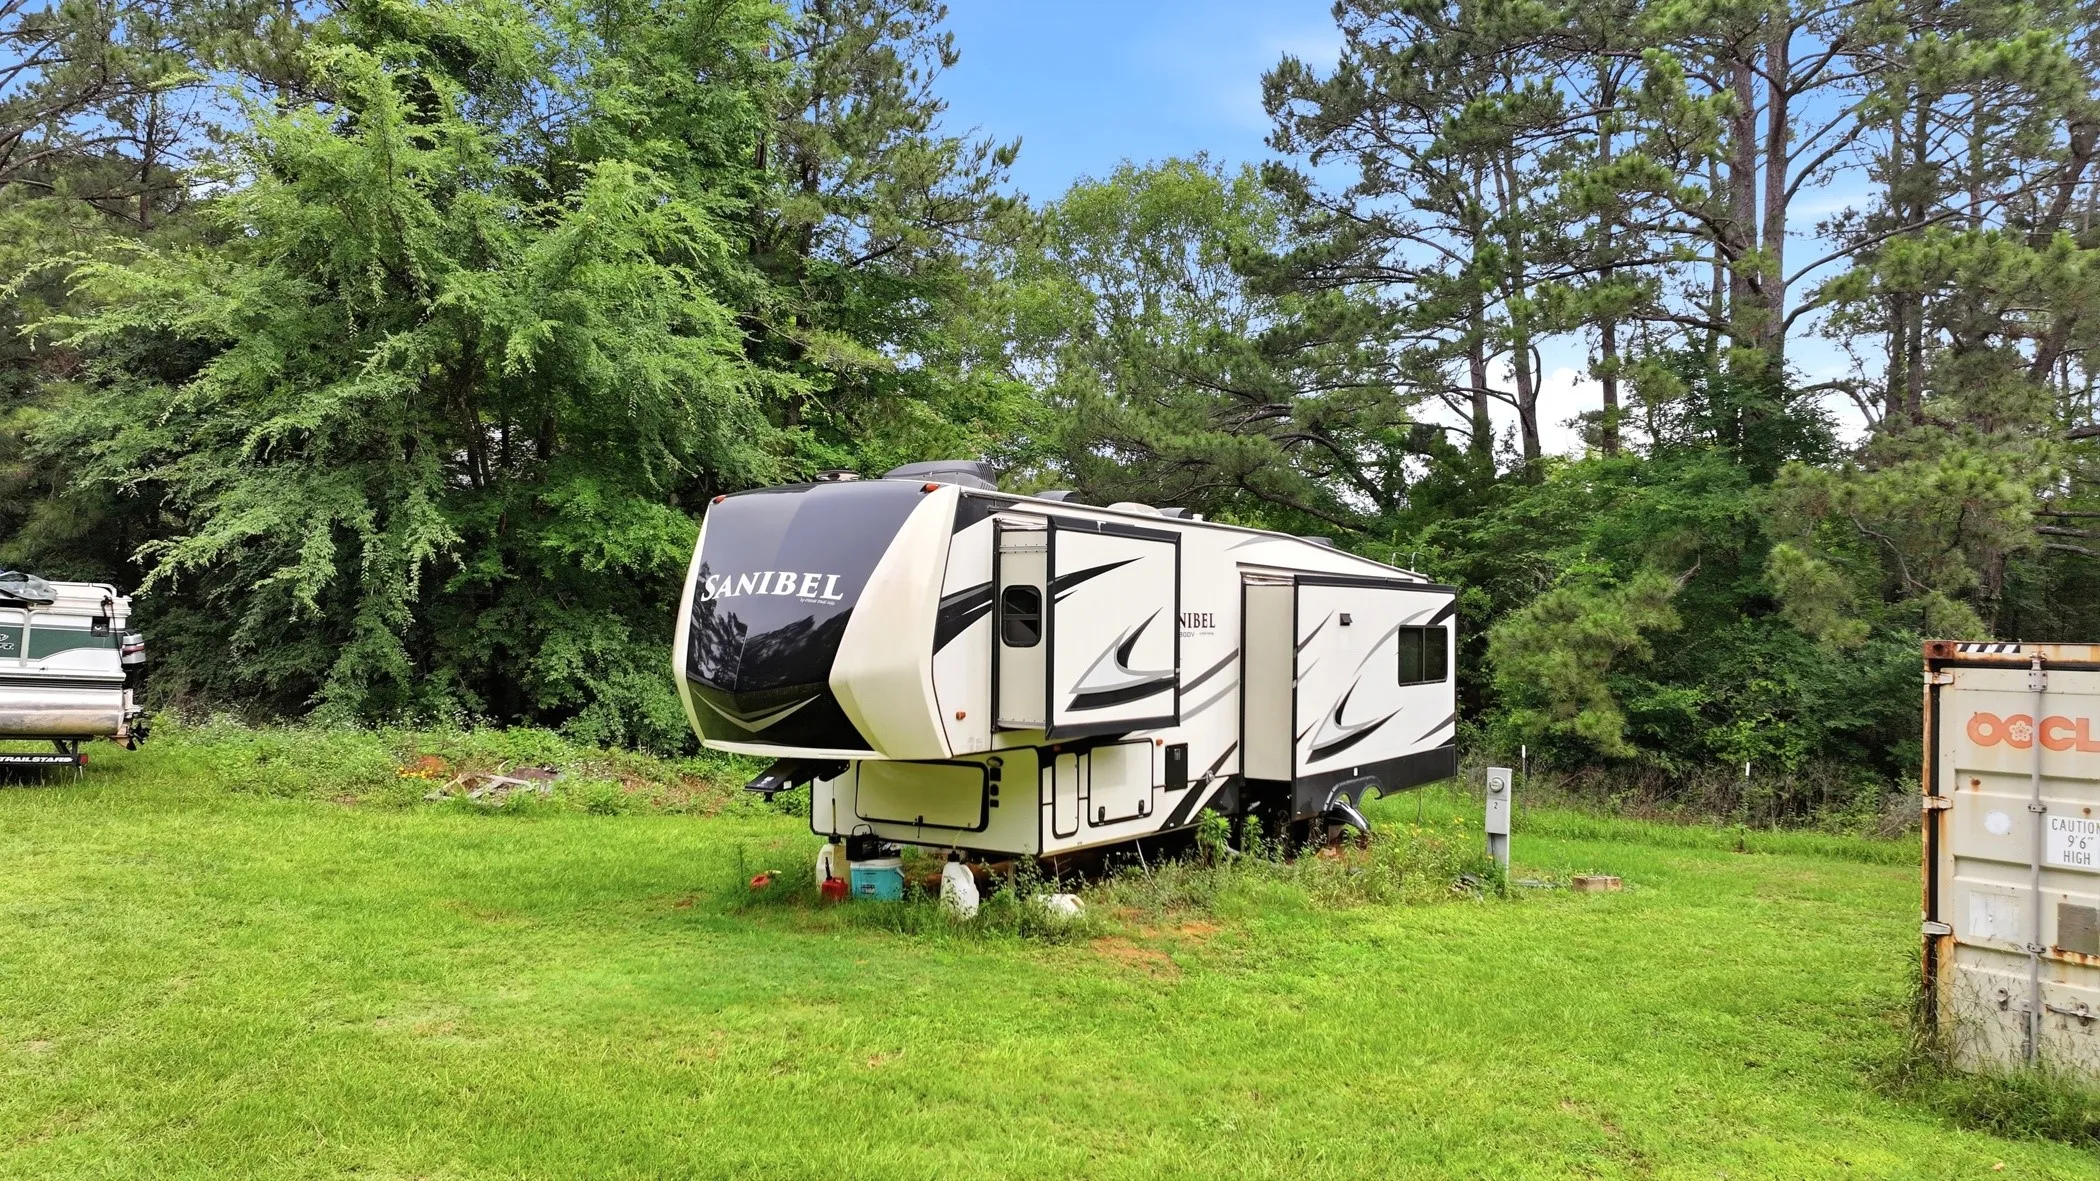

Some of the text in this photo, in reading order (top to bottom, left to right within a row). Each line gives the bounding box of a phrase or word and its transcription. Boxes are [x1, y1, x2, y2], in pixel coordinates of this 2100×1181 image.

[700, 571, 844, 602] SANIBEL
[1967, 712, 2100, 752] OOCL
[1493, 801, 1498, 809] 2
[2063, 849, 2091, 866] HIGH
